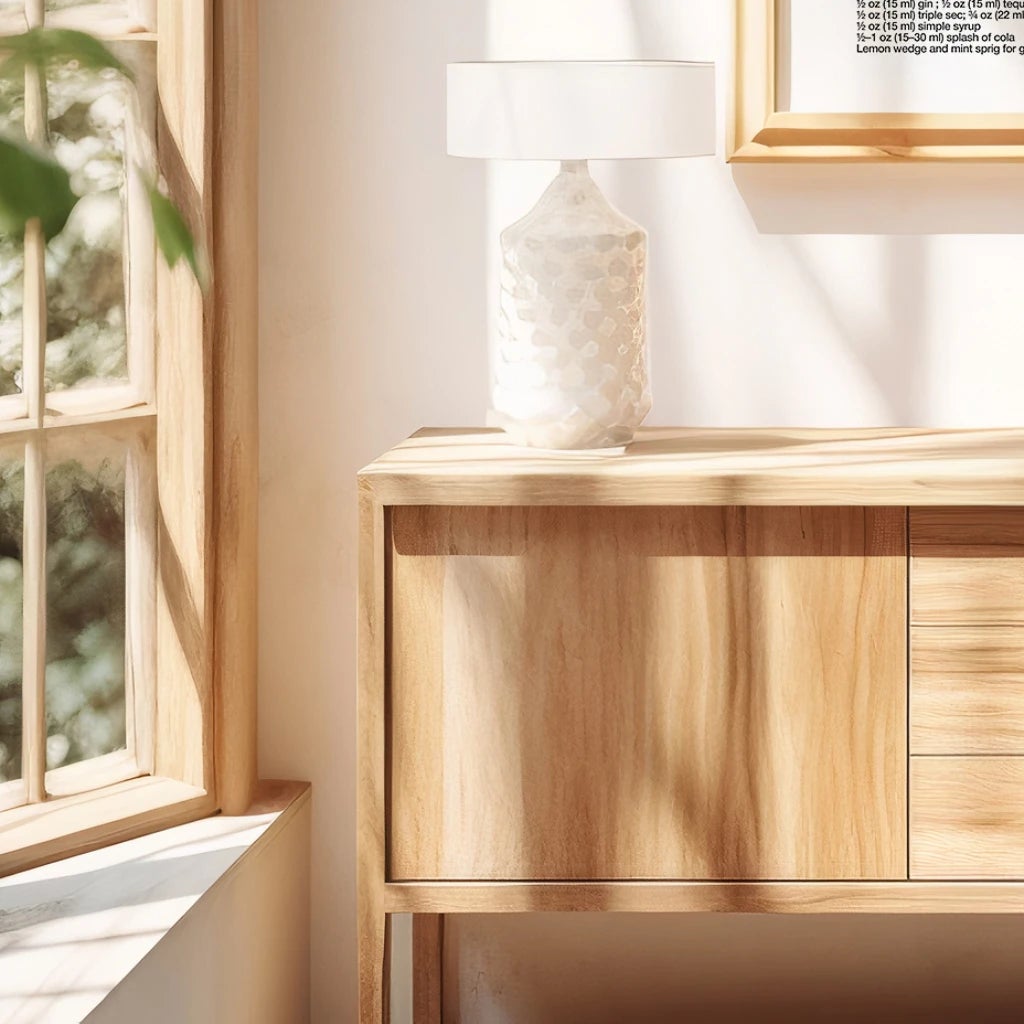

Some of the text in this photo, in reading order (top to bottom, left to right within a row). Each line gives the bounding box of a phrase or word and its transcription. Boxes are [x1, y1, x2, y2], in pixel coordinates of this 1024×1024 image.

[867, 0, 881, 9] oz
[952, 0, 966, 9] oz
[867, 11, 881, 20] oz
[882, 9, 899, 22] (15
[899, 9, 916, 22] ml)
[917, 9, 944, 22] triple
[945, 11, 966, 22] sec;
[979, 11, 993, 20] oz
[994, 9, 1011, 22] (22
[867, 23, 881, 31] oz
[882, 21, 899, 33] (15
[899, 21, 916, 33] ml)
[917, 21, 951, 33] simple
[952, 23, 982, 33] syrup
[878, 34, 893, 43] oz
[928, 32, 945, 44] ml)
[946, 32, 980, 44] splash
[981, 32, 992, 43] of
[993, 32, 1016, 43] cola
[856, 43, 892, 54] Lemon
[892, 43, 928, 56] wedge
[928, 43, 949, 54] and
[950, 43, 973, 54] mint
[974, 43, 1001, 56] sprig
[1002, 43, 1017, 54] for
